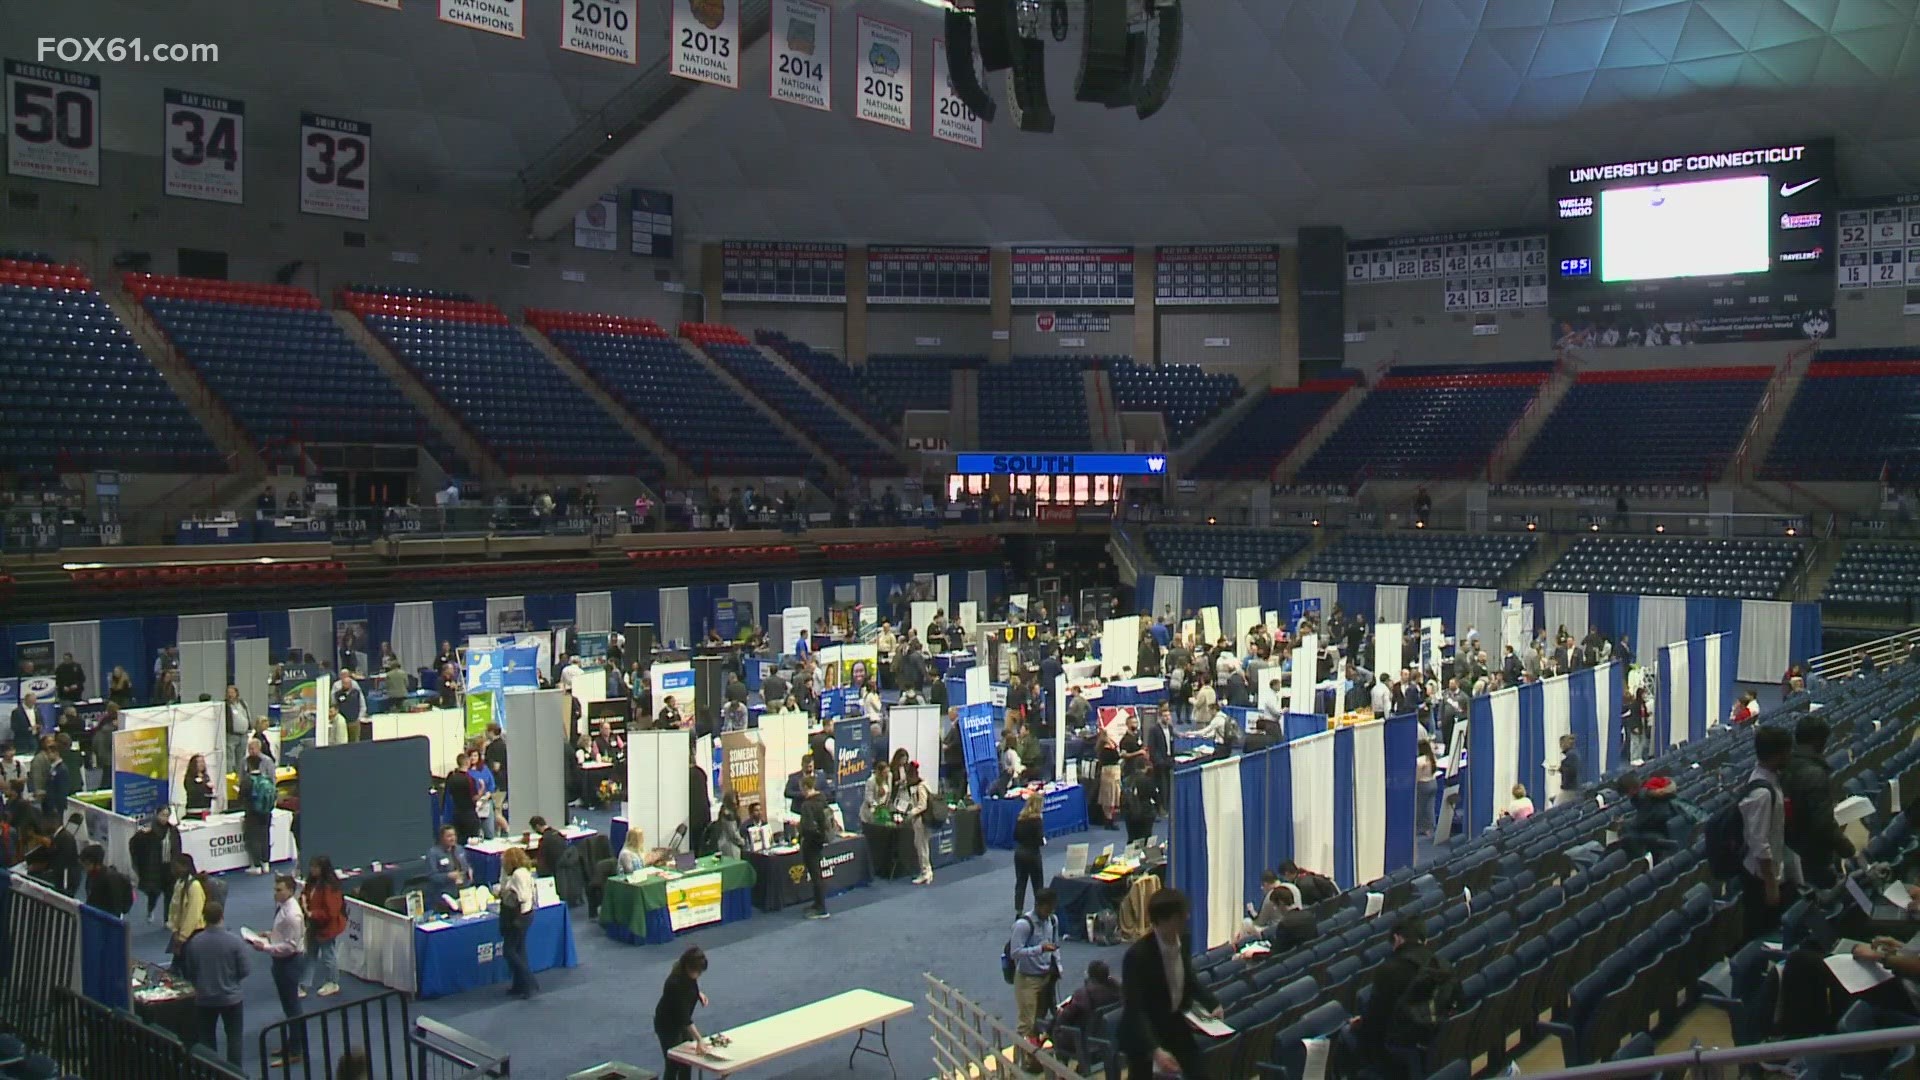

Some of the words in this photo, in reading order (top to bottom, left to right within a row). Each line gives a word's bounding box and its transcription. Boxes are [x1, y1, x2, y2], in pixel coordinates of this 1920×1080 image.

[448, 9, 514, 32] CHAMPIONS
[572, 0, 628, 31] 2010
[575, 25, 624, 45] NATIONAL
[682, 28, 730, 57] 2013
[570, 38, 629, 59] CHAMPIONS
[683, 52, 728, 71] NATIONAL
[779, 54, 823, 81] 2014
[679, 64, 731, 84] CHAMPIONS
[781, 78, 820, 94] NATIONAL
[864, 77, 903, 102] 2015
[181, 93, 199, 105] RAY
[201, 98, 228, 110] ALLEN
[777, 88, 824, 106] CHAMPIONS
[866, 98, 902, 114] NATIONAL
[15, 81, 93, 149] 50
[863, 109, 906, 126] CHAMPIONS
[942, 119, 974, 133] NATIONAL
[171, 110, 237, 171] 34
[939, 129, 977, 144] CHAMPIONS
[306, 133, 365, 190] 32
[1569, 159, 1659, 184] UNIVERSITY
[1661, 157, 1683, 174] OF
[1686, 146, 1806, 171] CONNECTICUT
[1559, 197, 1593, 208] WELLS
[1560, 207, 1593, 218] FARGO
[1843, 227, 1864, 242] 52
[1448, 257, 1465, 270] 42
[1473, 255, 1490, 268] 44
[1526, 251, 1544, 264] 42
[1561, 259, 1588, 271] CBS
[1353, 266, 1363, 278] C
[1379, 264, 1386, 275] 9
[1398, 262, 1415, 274] 22
[1422, 260, 1440, 272] 25
[1848, 267, 1859, 281] 15
[1881, 266, 1894, 280] 22
[1448, 292, 1465, 305] 24
[1476, 291, 1489, 303] 13
[1500, 289, 1517, 302] 22
[993, 456, 1075, 472] SOUTH
[964, 714, 992, 730] Impact
[729, 746, 758, 762] SOMEDAY
[838, 747, 859, 766] Your
[730, 760, 759, 778] STARTS
[820, 852, 855, 868] thwestern
